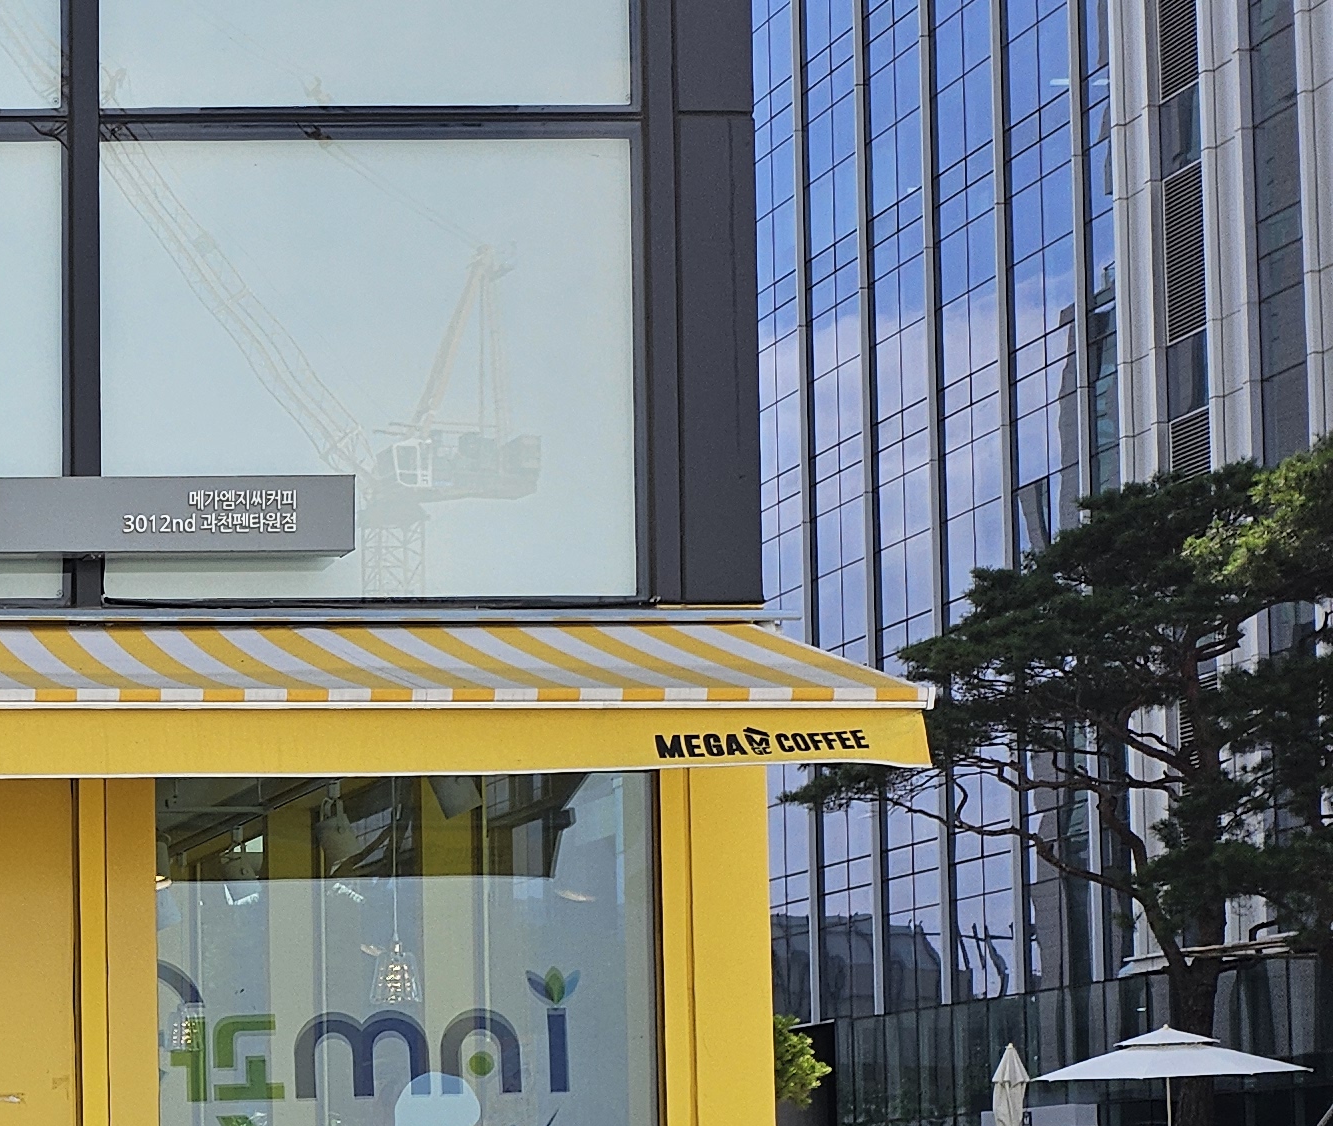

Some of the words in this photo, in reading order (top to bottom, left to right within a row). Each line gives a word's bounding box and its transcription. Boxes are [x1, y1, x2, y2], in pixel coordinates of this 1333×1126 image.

[188, 489, 298, 511] 메가엠지씨커피
[122, 513, 196, 533] 3012nd
[200, 511, 298, 533] 과천펜타원점
[654, 732, 748, 759] MEGA
[775, 729, 870, 753] COFFEE
